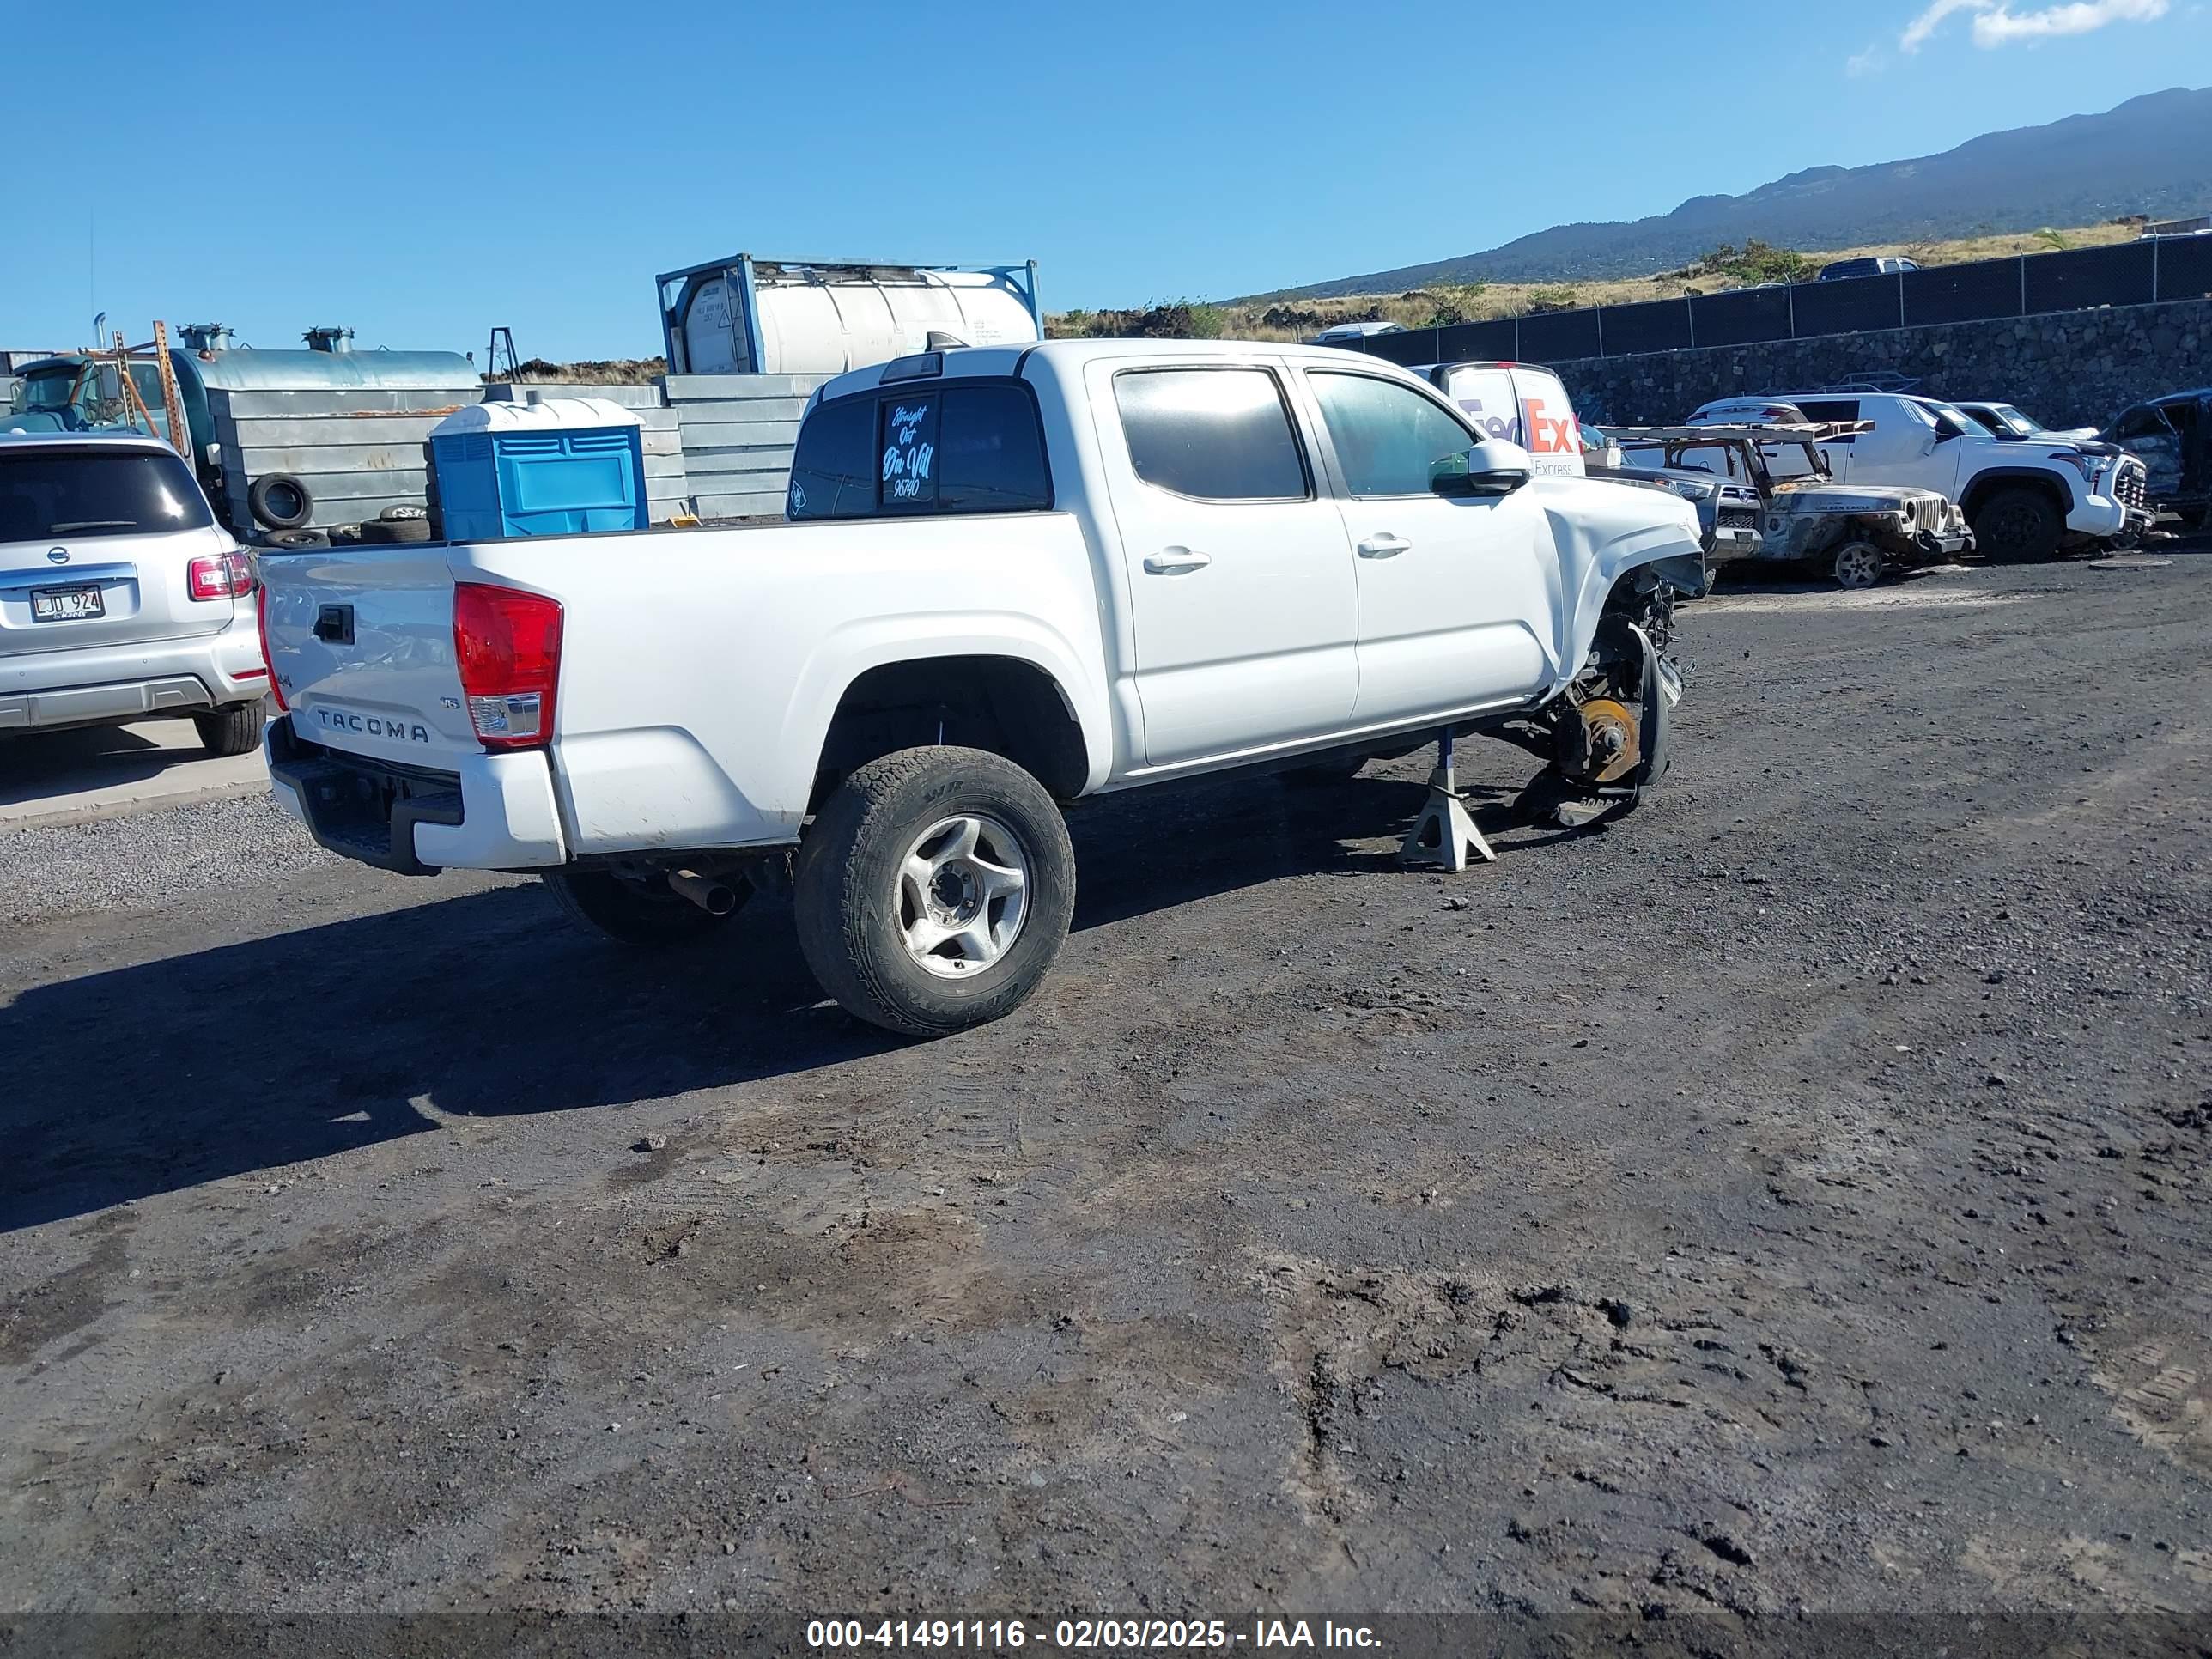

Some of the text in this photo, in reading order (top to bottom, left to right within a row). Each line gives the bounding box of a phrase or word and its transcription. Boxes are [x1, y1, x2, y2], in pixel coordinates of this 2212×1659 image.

[892, 405, 927, 428] Straight
[900, 426, 916, 446] Out
[894, 479, 919, 497] 96740
[71, 593, 100, 611] 924
[318, 709, 428, 743] TACOMA
